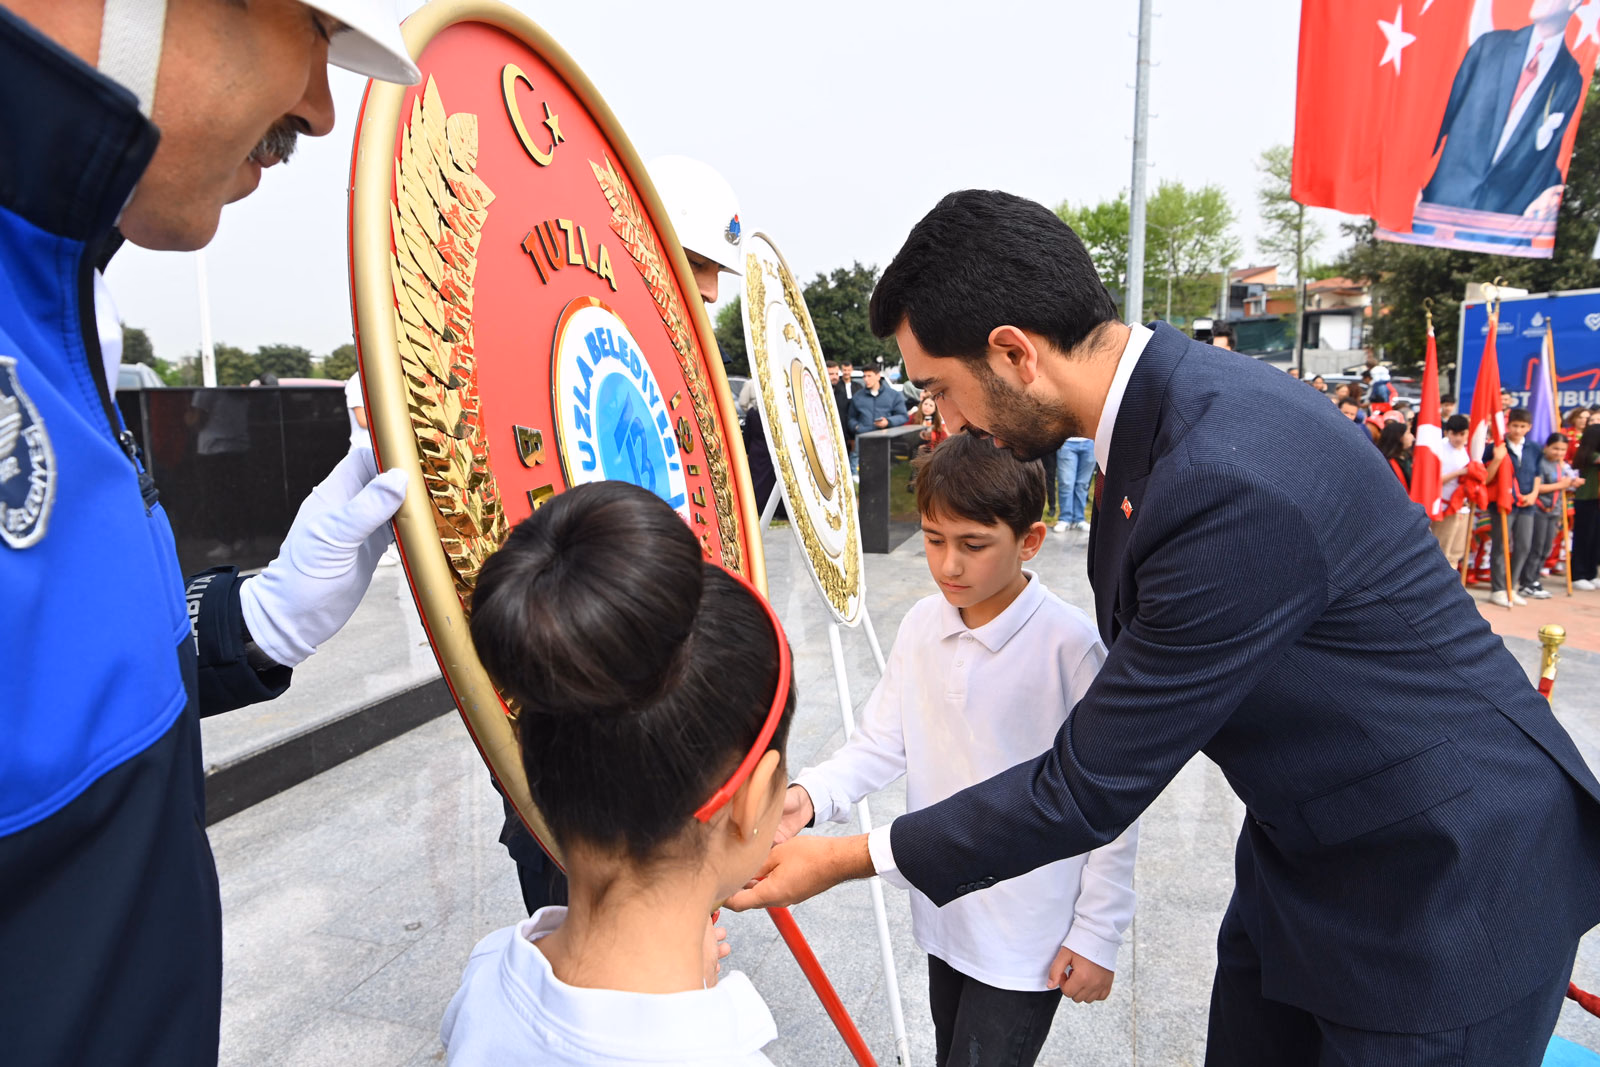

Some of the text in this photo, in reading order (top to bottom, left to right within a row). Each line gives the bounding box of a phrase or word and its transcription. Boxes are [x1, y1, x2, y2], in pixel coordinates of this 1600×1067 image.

[520, 218, 618, 292] TUZLA
[573, 355, 598, 483] UZLA
[186, 574, 217, 656] ABITA
